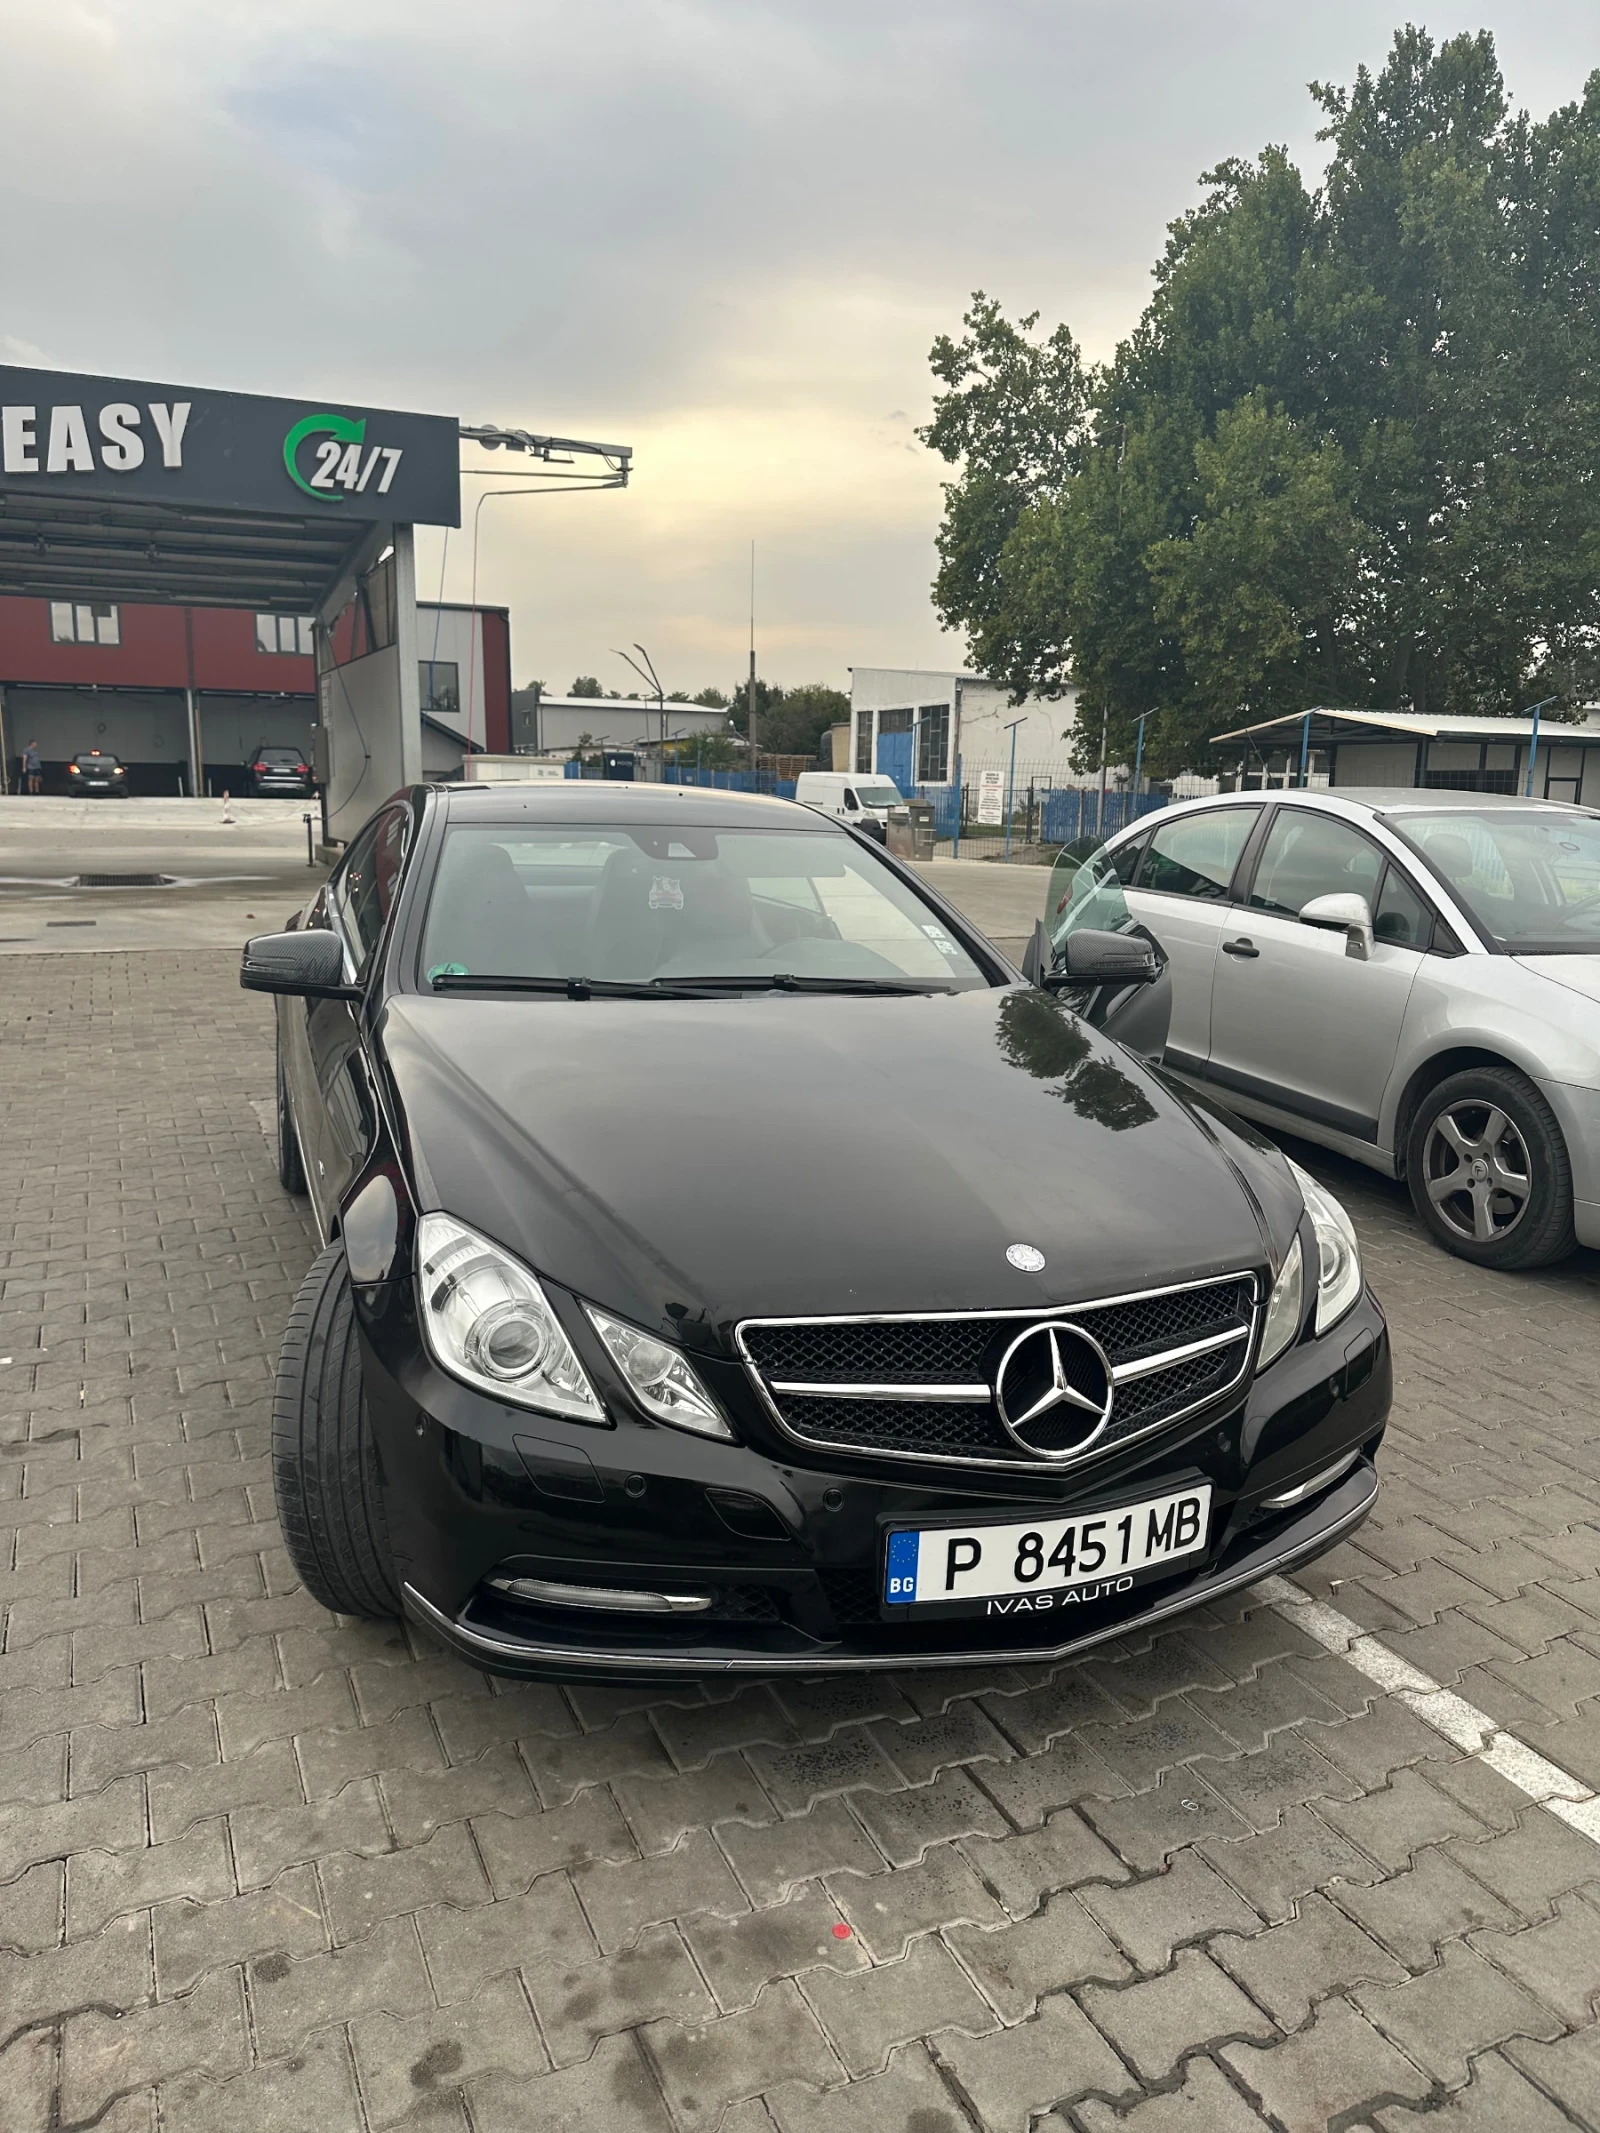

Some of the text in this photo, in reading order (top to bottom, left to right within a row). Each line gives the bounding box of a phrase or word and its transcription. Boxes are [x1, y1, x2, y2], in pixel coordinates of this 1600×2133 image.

[2, 402, 192, 472] EASY
[310, 441, 404, 493] 24/7
[945, 1497, 1201, 1591] P 8451 MB
[889, 1576, 915, 1594] BG
[986, 1575, 1134, 1615] IVAS AUTO
